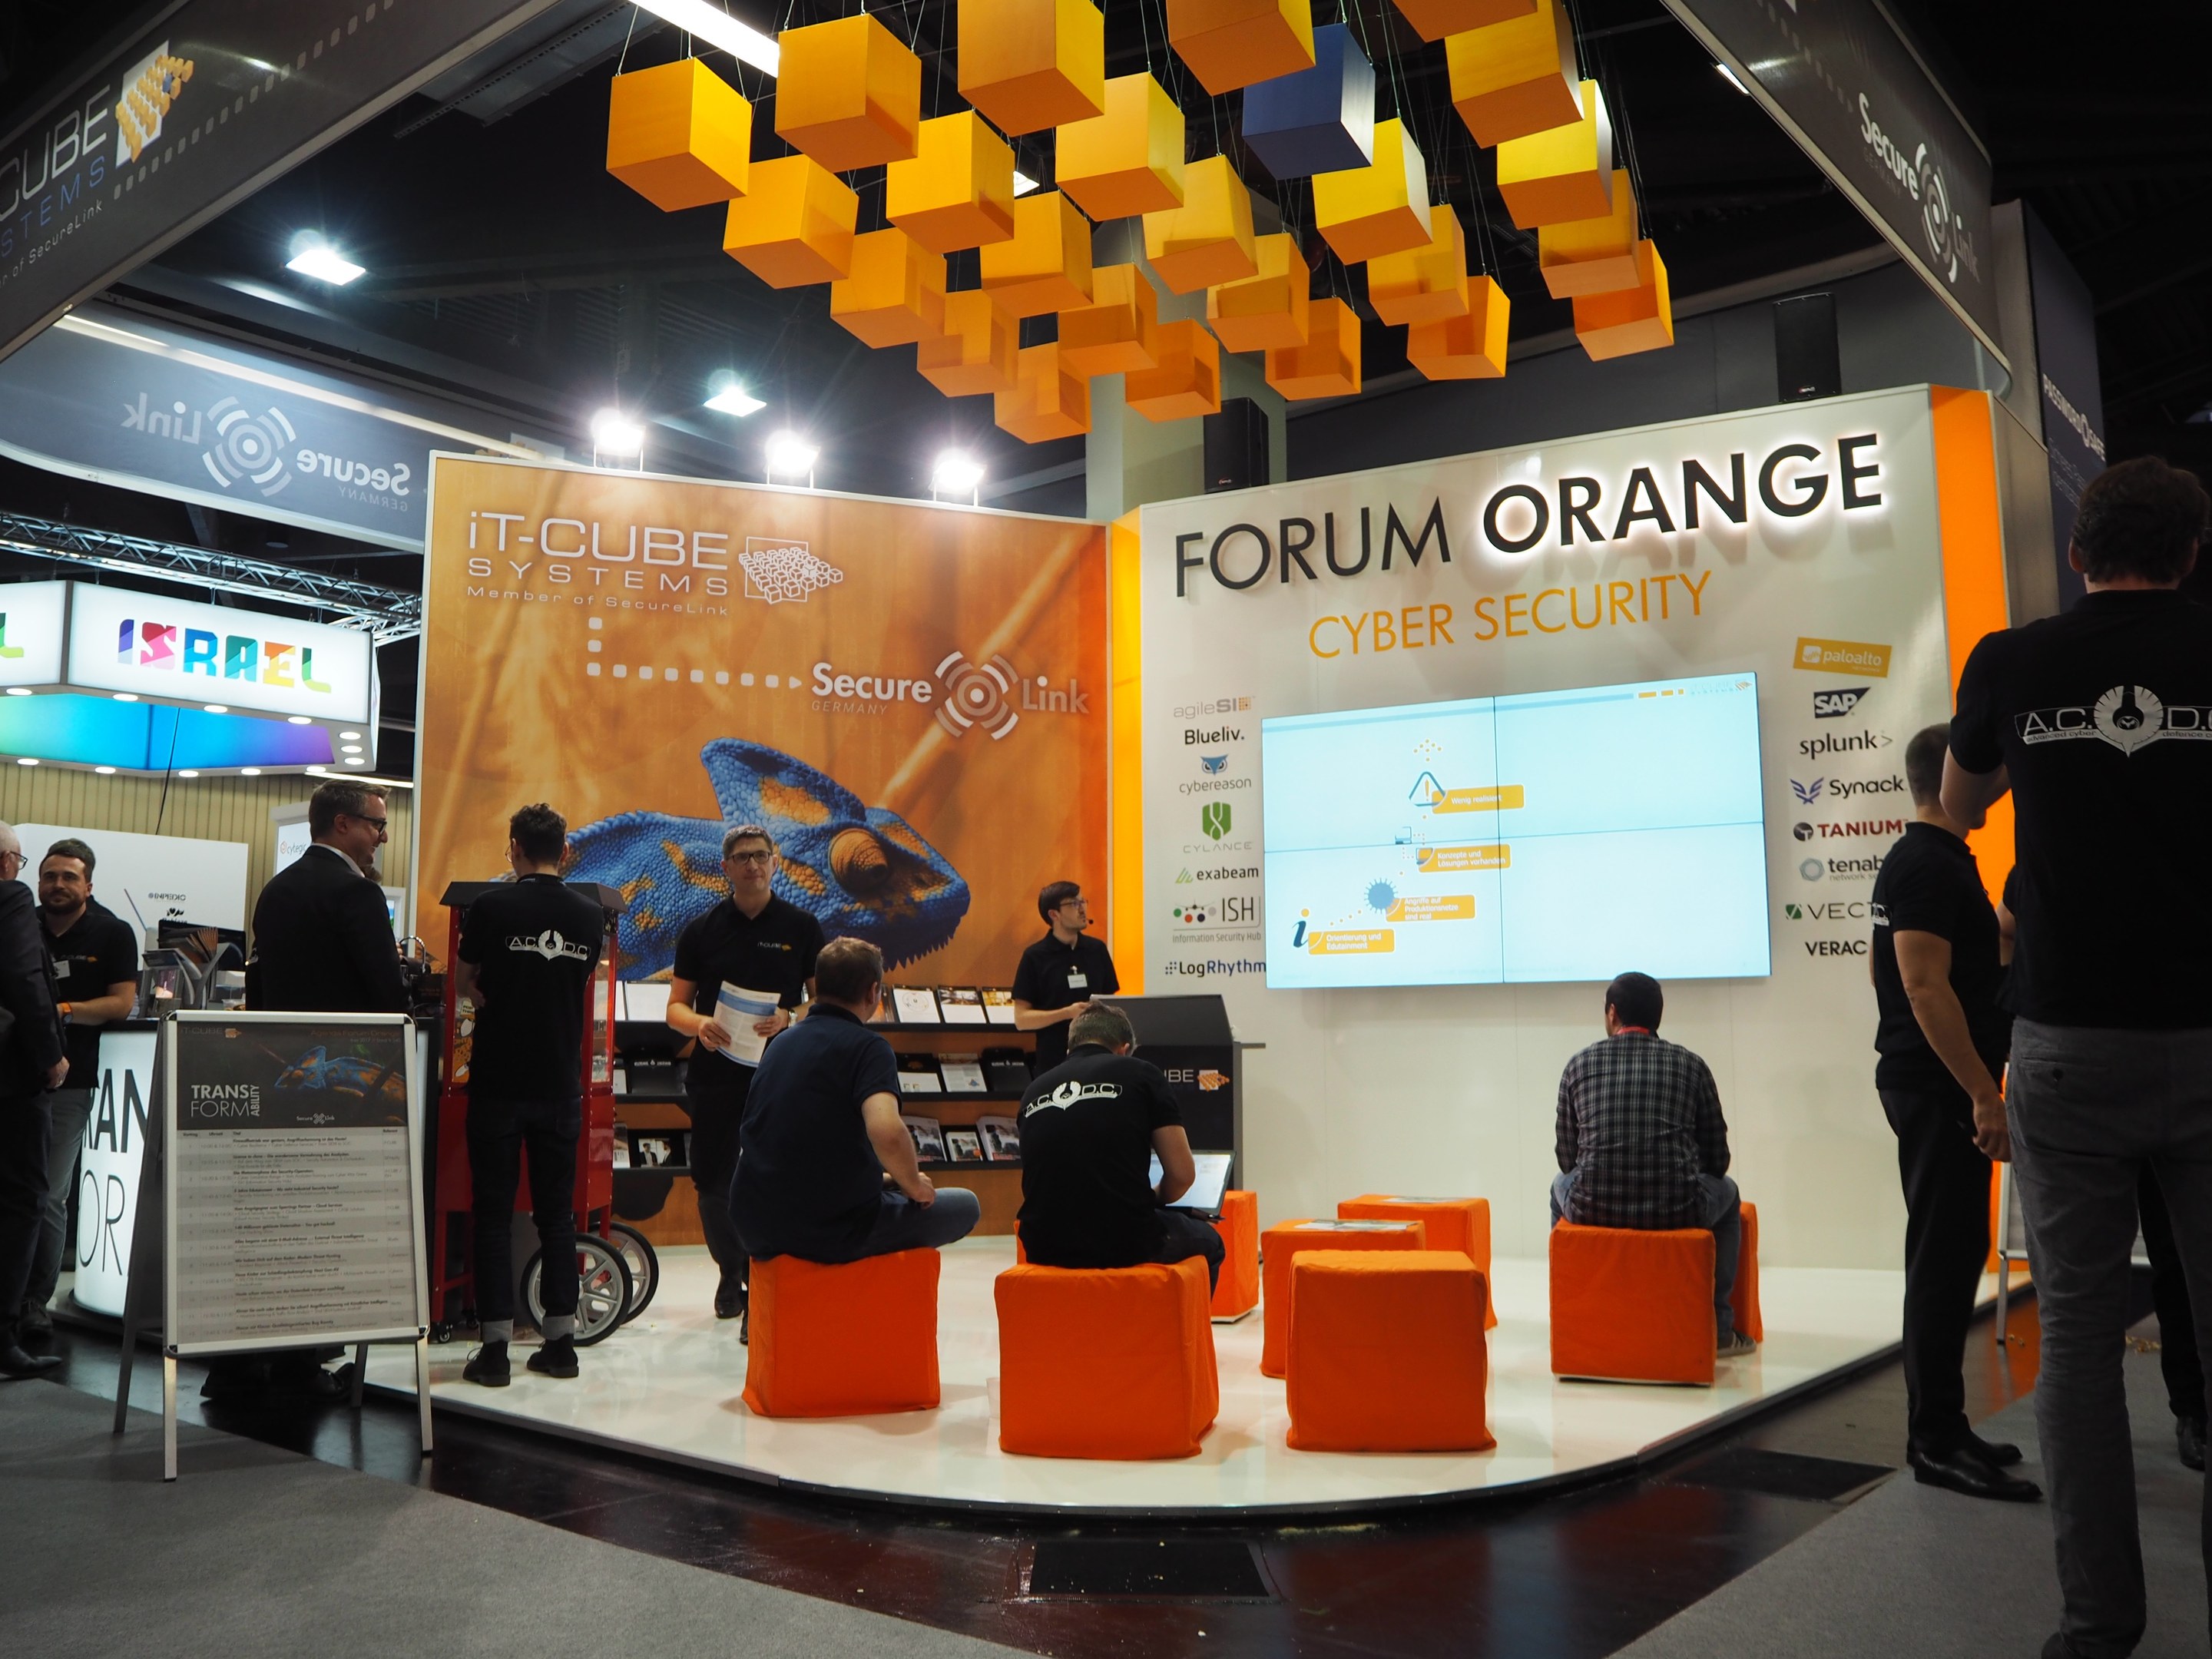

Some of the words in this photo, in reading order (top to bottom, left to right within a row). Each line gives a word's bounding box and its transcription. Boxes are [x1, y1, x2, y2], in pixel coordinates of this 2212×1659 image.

[1859, 92, 1919, 201] Secure
[29, 198, 103, 265] SecureLink
[1176, 495, 1452, 598] FORUM
[1482, 433, 1883, 554] ORANGE
[468, 557, 728, 596] SYSTEMS
[467, 586, 561, 602] Member
[574, 595, 594, 605] of
[605, 596, 727, 615] SecureLink
[1308, 603, 1455, 659] CYBER
[1473, 570, 1713, 643] SECURITY
[117, 618, 332, 694] ISRAEL
[1822, 649, 1883, 667] paloalto
[811, 661, 932, 704] Secure
[1022, 675, 1089, 715] Link
[811, 700, 888, 715] GERMANY
[1813, 692, 1859, 714] SAP
[2026, 730, 2067, 743] advanced
[2068, 730, 2097, 740] cyber
[2162, 730, 2204, 738] defence
[1178, 777, 1252, 796] cybereason
[1816, 819, 1904, 839] TANIUM
[1182, 841, 1253, 854] CYLANCE
[1196, 867, 1259, 882] exabeam
[1829, 873, 1865, 882] network
[1221, 896, 1254, 922] ISH
[1172, 933, 1215, 944] Information
[1216, 932, 1246, 943] Security
[1246, 932, 1262, 942] Hub
[1179, 959, 1267, 978] LogRhythm
[190, 1084, 250, 1100] TRANS
[250, 1084, 260, 1117] ABILITY
[190, 1100, 250, 1118] FORM
